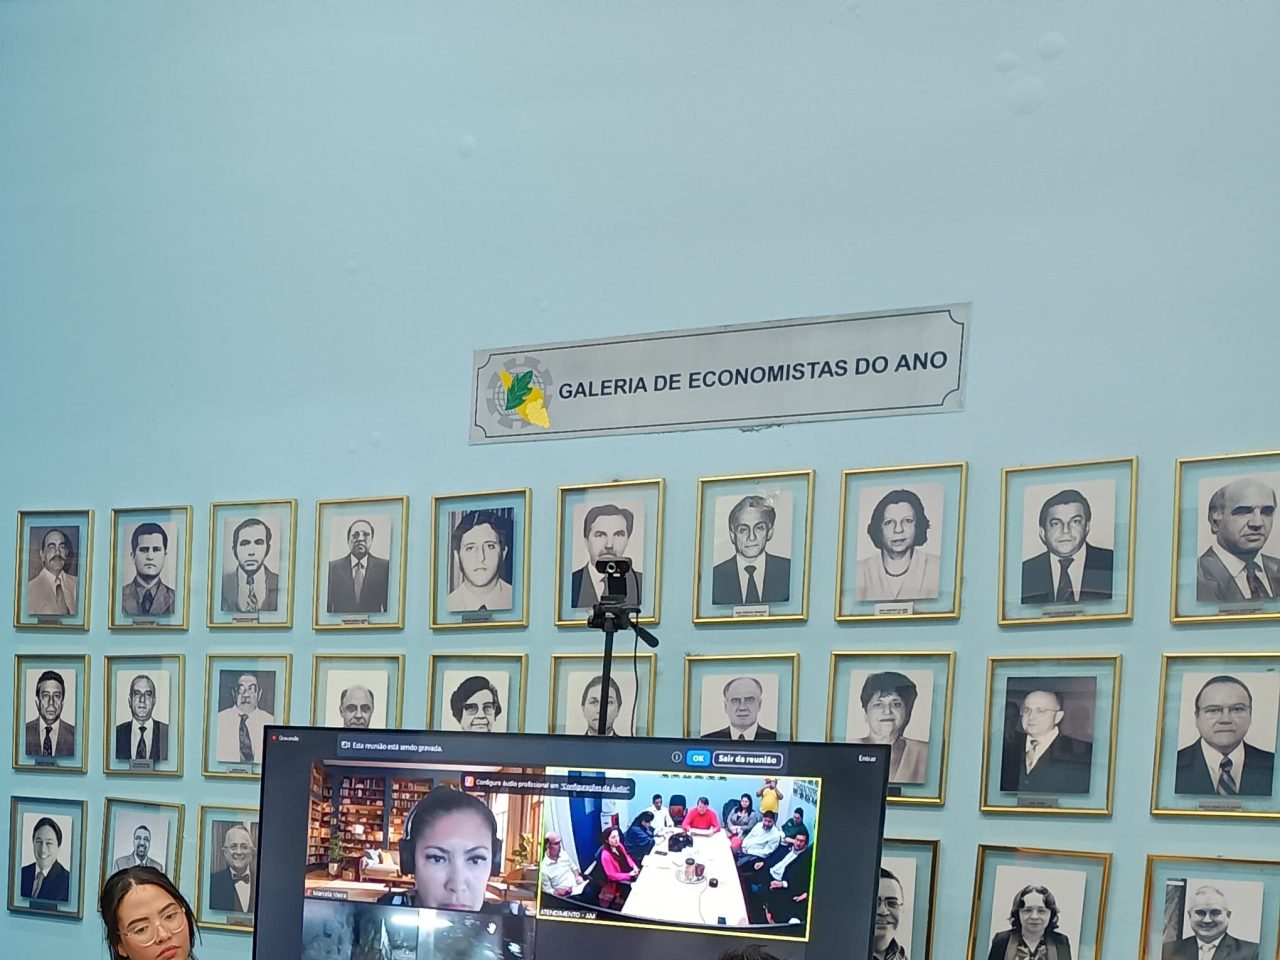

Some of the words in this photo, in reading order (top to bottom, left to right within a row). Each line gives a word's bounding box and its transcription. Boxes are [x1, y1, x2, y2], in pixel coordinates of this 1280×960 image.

[558, 376, 648, 400] GALERIA
[653, 373, 682, 392] DE
[688, 359, 849, 389] ECONOMISTAS
[855, 356, 889, 376] DO
[894, 351, 949, 372] ANO
[352, 741, 364, 749] Esta
[365, 742, 387, 750] reunião
[400, 743, 418, 751] sendo
[692, 754, 704, 762] OK
[718, 754, 734, 763] Sair
[735, 755, 745, 764] da
[746, 755, 777, 764] reunião
[540, 909, 581, 918] ATENDIMENTO
